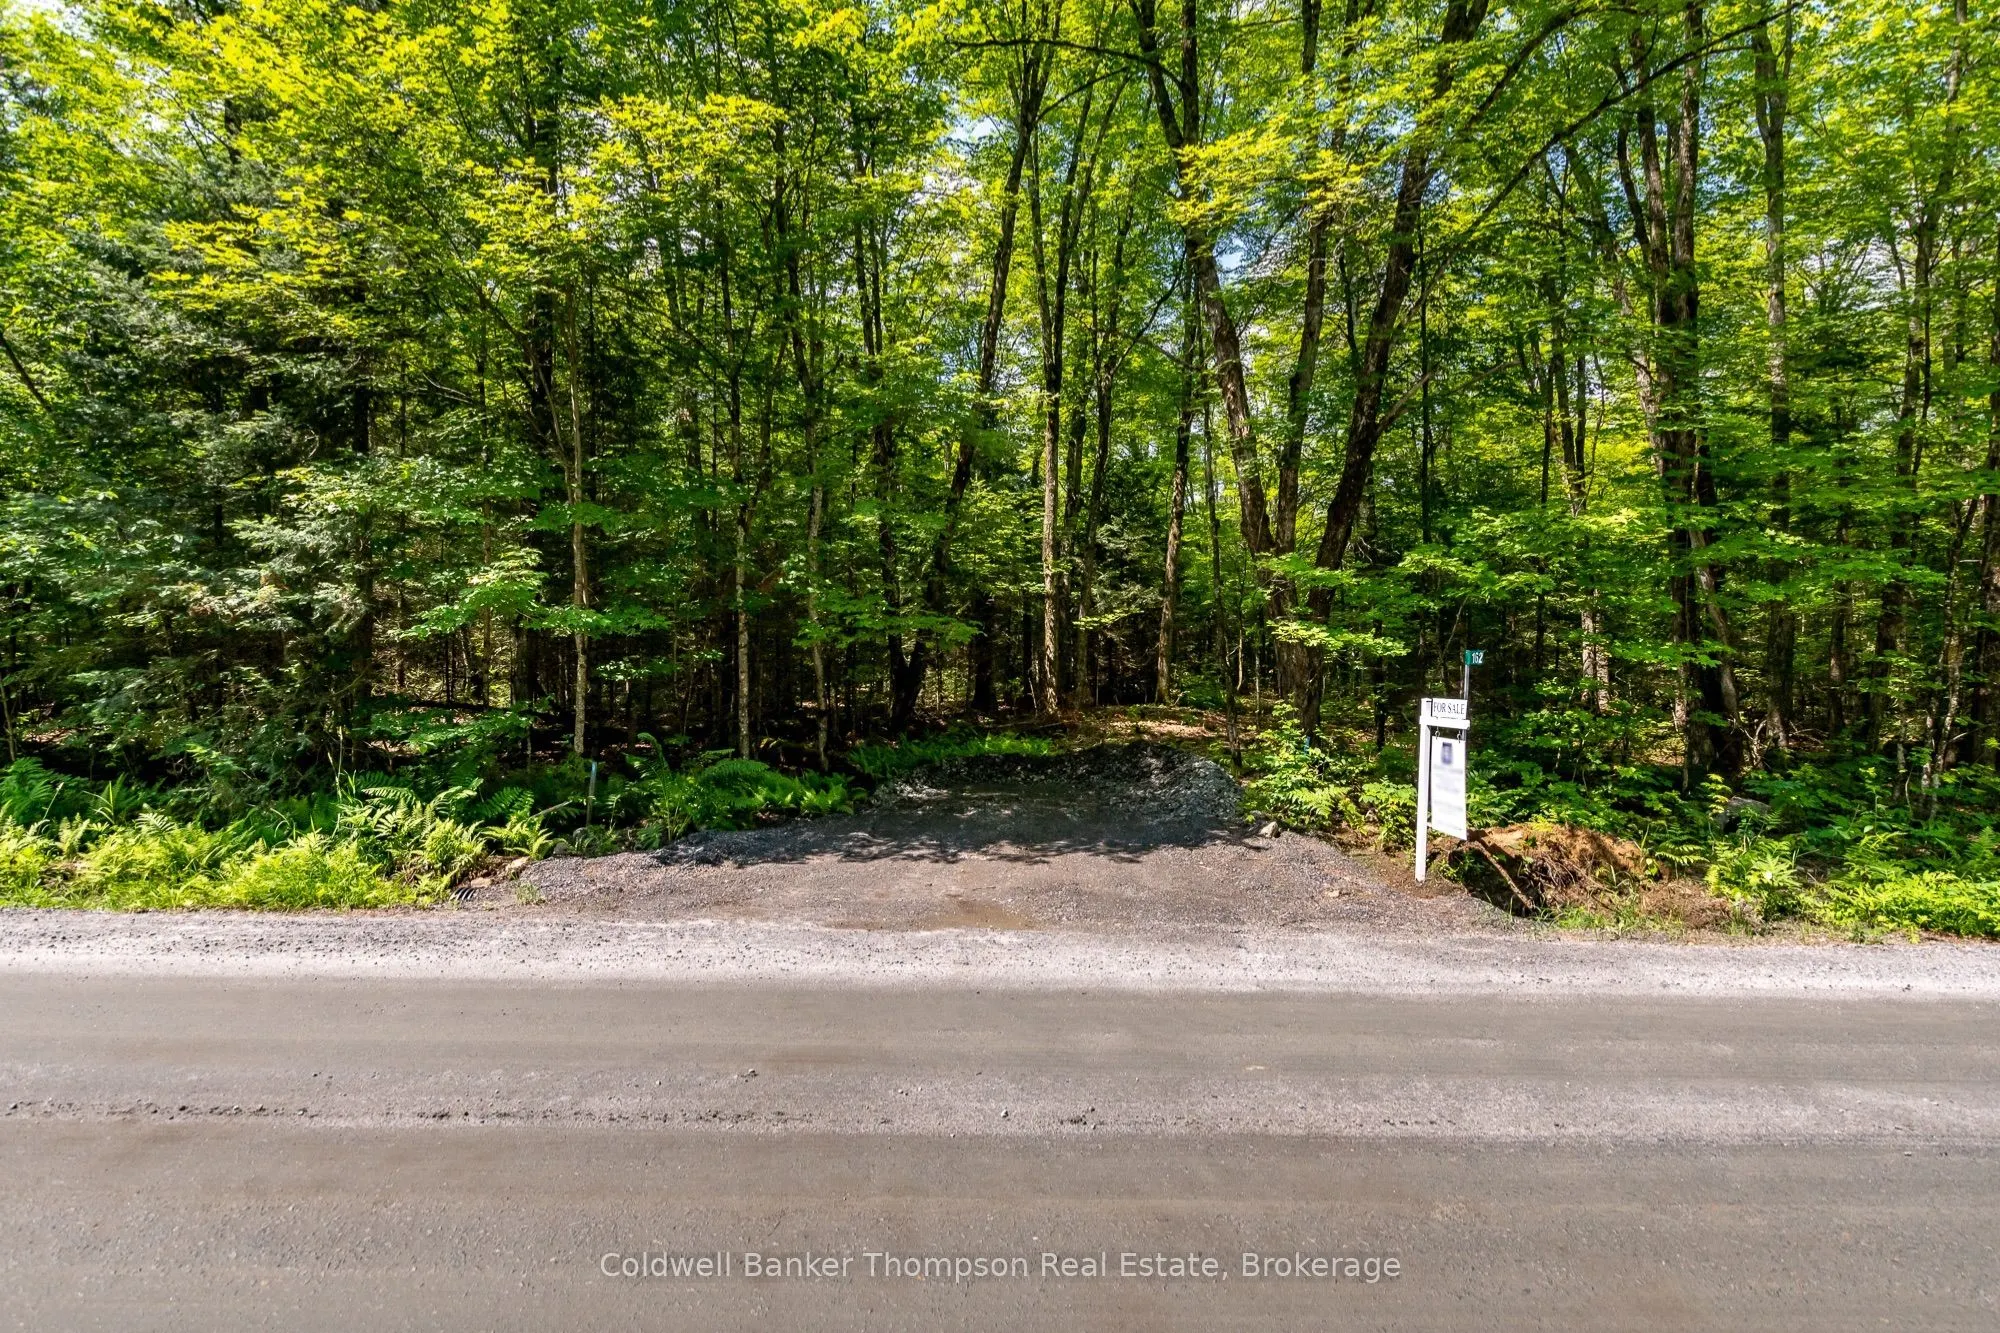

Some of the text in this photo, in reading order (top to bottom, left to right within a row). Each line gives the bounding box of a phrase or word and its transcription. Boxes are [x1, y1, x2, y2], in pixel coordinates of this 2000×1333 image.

[1471, 652, 1483, 663] 162
[1433, 702, 1465, 715] FOR SALE
